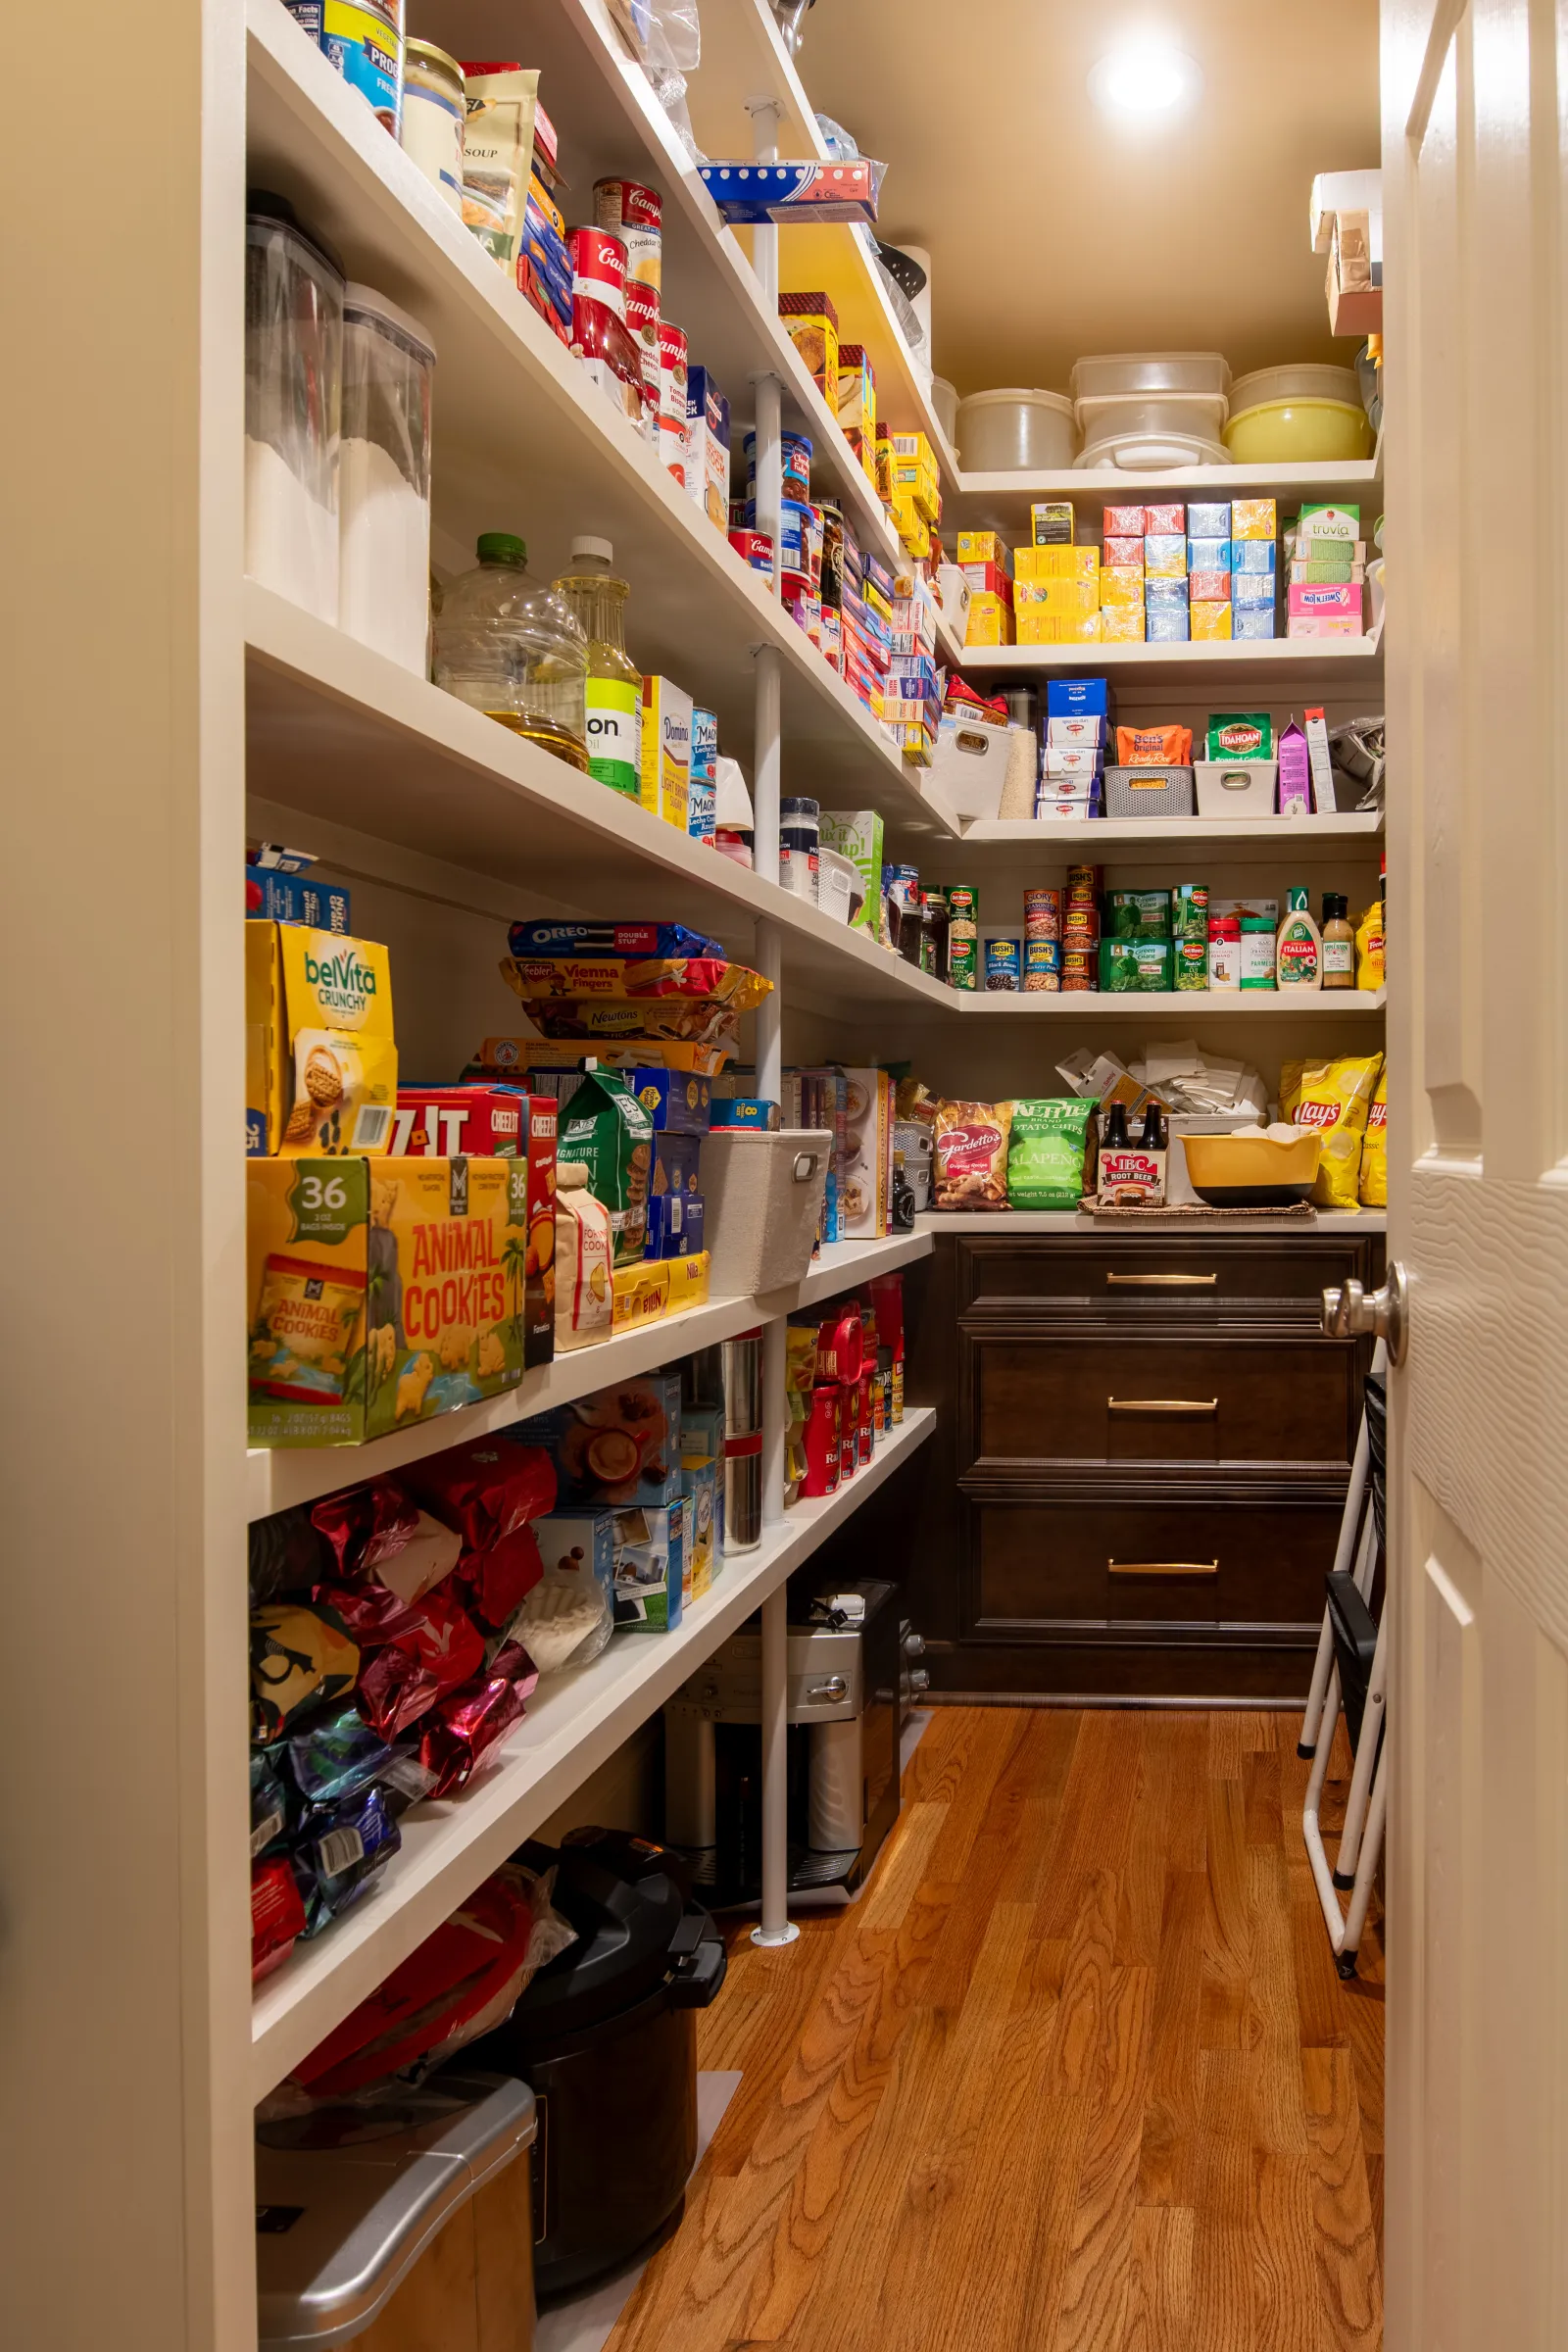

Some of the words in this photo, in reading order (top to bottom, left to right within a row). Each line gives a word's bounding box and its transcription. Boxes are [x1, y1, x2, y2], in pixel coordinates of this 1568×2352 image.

[464, 148, 498, 158] SOUP
[632, 222, 650, 233] GREAT
[630, 238, 657, 249] Cheddar
[626, 298, 661, 324] ampb
[1313, 523, 1349, 535] truvía
[663, 716, 689, 741] Domino
[1134, 734, 1163, 744] Ben's
[1222, 733, 1260, 746] IDAHOAN
[1134, 744, 1163, 753] Original
[1129, 754, 1153, 764] Ready
[1153, 753, 1170, 762] Rice
[662, 775, 675, 793] LIGHT
[674, 784, 690, 804] BROWN
[669, 795, 683, 811] SUGAR
[838, 828, 848, 842] it
[838, 837, 865, 860] up!
[1027, 893, 1053, 902] GLORY
[532, 926, 588, 944] OREO
[991, 945, 1014, 954] BUSH'S
[1029, 946, 1054, 955] BUSH'S
[305, 949, 376, 995] belVita
[564, 964, 619, 979] Vienna
[572, 978, 612, 990] Fingers
[318, 989, 367, 1009] CRUNCHY
[592, 1009, 638, 1025] Newtons
[1013, 1100, 1090, 1118] KETTLE
[1300, 1102, 1340, 1127] Lay's
[1012, 1123, 1049, 1132] OTATO
[1052, 1123, 1083, 1135] CHIPS
[557, 1148, 600, 1159] IGNATURE
[937, 1131, 1002, 1166] Gardetto's
[1118, 1158, 1146, 1171] IBC
[1133, 1172, 1152, 1182] BEER
[511, 1172, 525, 1199] 36
[301, 1176, 346, 1209] 36
